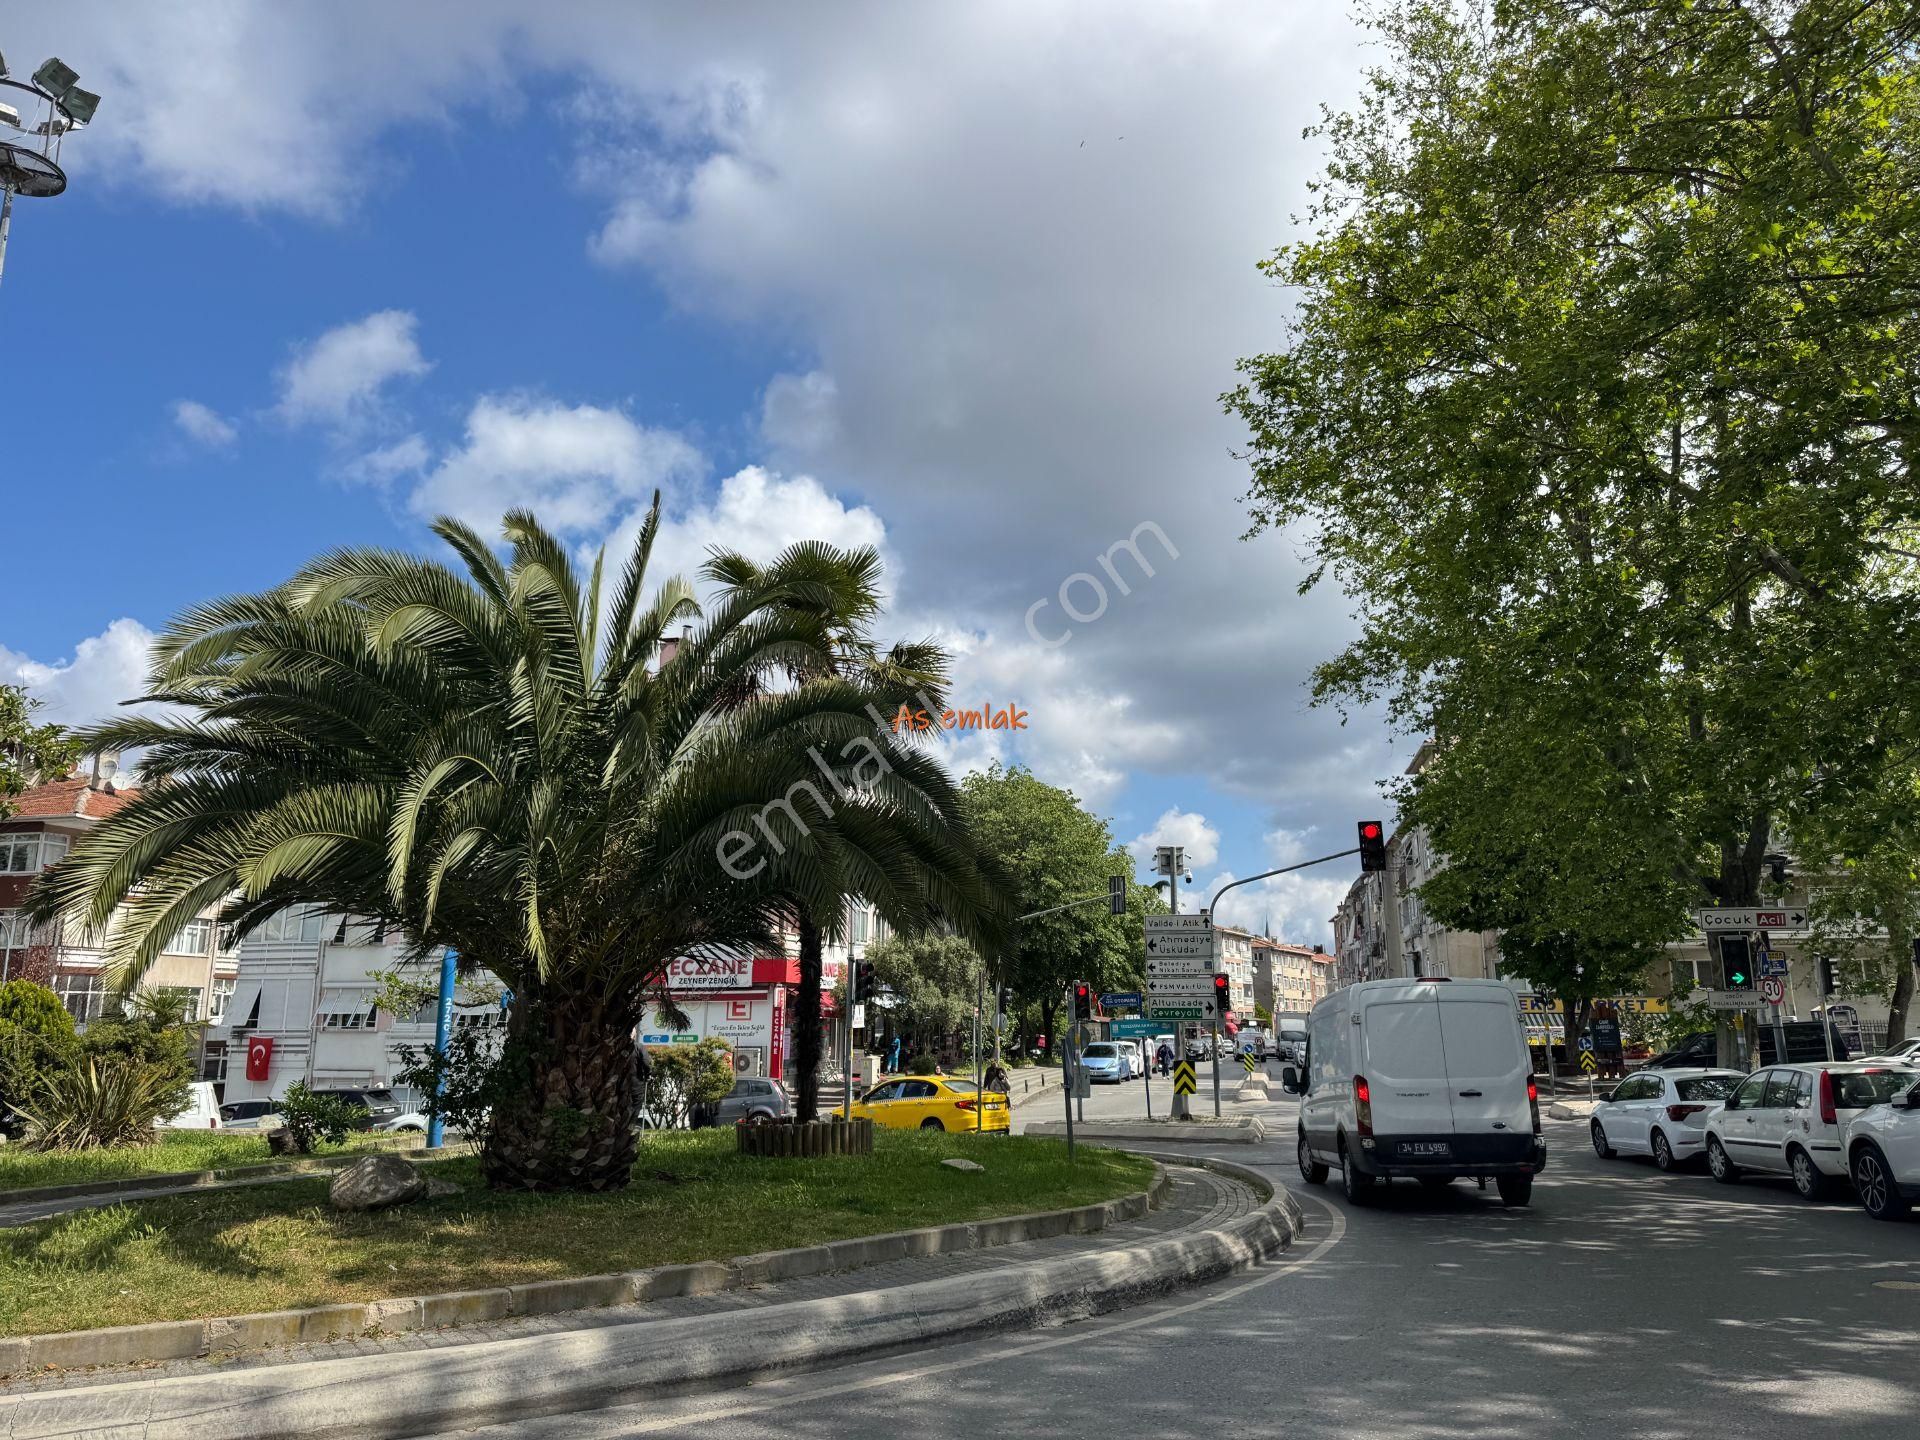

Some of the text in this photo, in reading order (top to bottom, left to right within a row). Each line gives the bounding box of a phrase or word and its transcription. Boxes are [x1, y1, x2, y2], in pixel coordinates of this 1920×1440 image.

[1704, 914, 1784, 925] Çocuk Acil
[1159, 936, 1211, 944] Ahmediye
[1159, 945, 1199, 954] Üsküdar
[670, 959, 748, 976] ECZANE
[678, 977, 708, 985] ZEYNEP
[1765, 982, 1780, 997] 30
[1152, 1009, 1202, 1017] Çevreyolu
[772, 1010, 780, 1055] ECZANE
[1402, 1143, 1412, 1152] 34
[1428, 1143, 1447, 1152] 4997
